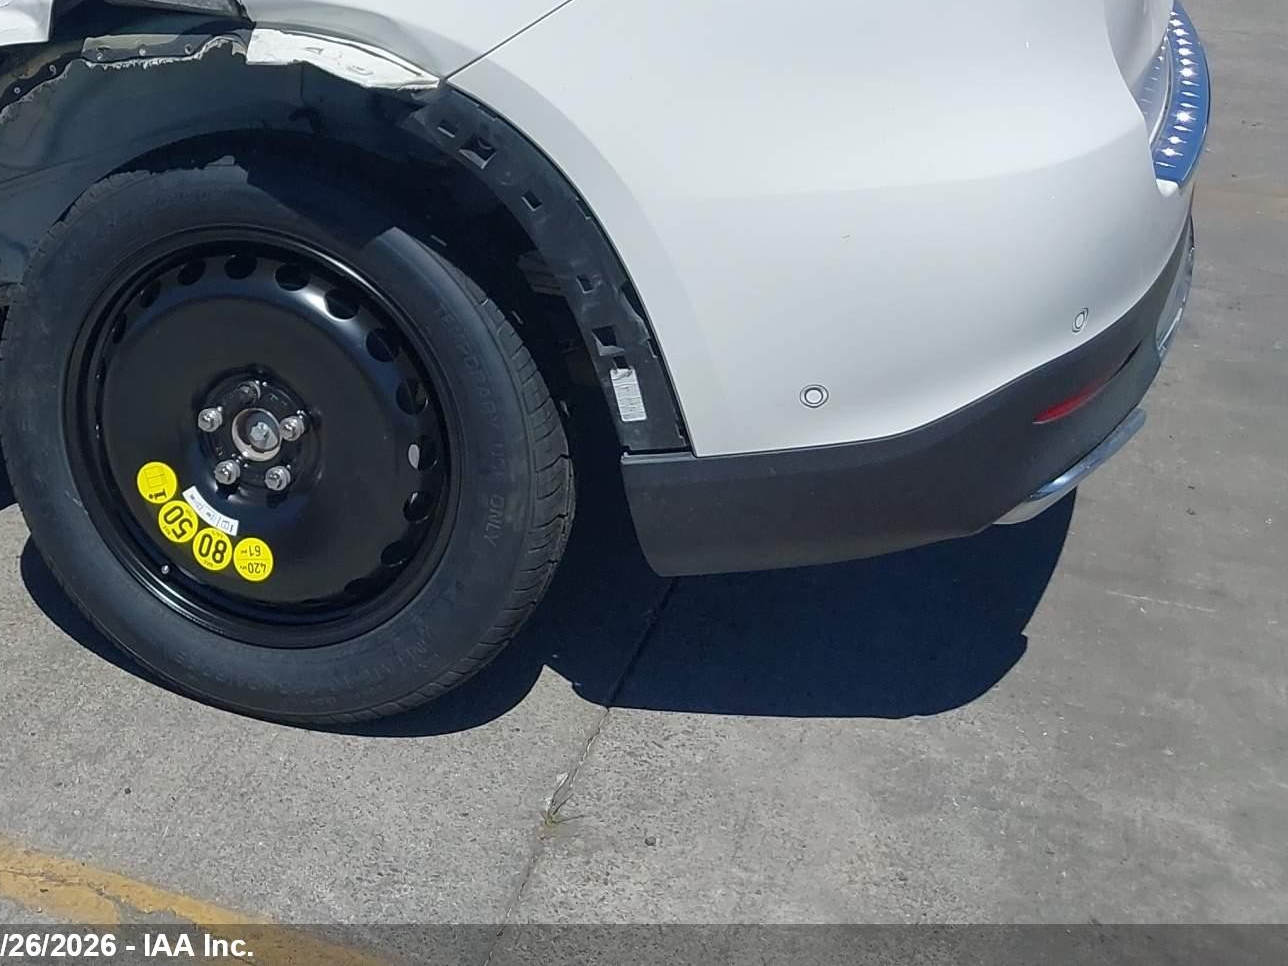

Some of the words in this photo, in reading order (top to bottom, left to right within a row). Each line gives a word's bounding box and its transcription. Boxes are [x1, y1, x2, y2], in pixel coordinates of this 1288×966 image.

[163, 505, 194, 540] 50
[482, 492, 506, 547] ONLY
[198, 533, 228, 564] 80
[248, 544, 261, 557] 61
[247, 561, 267, 574] 420
